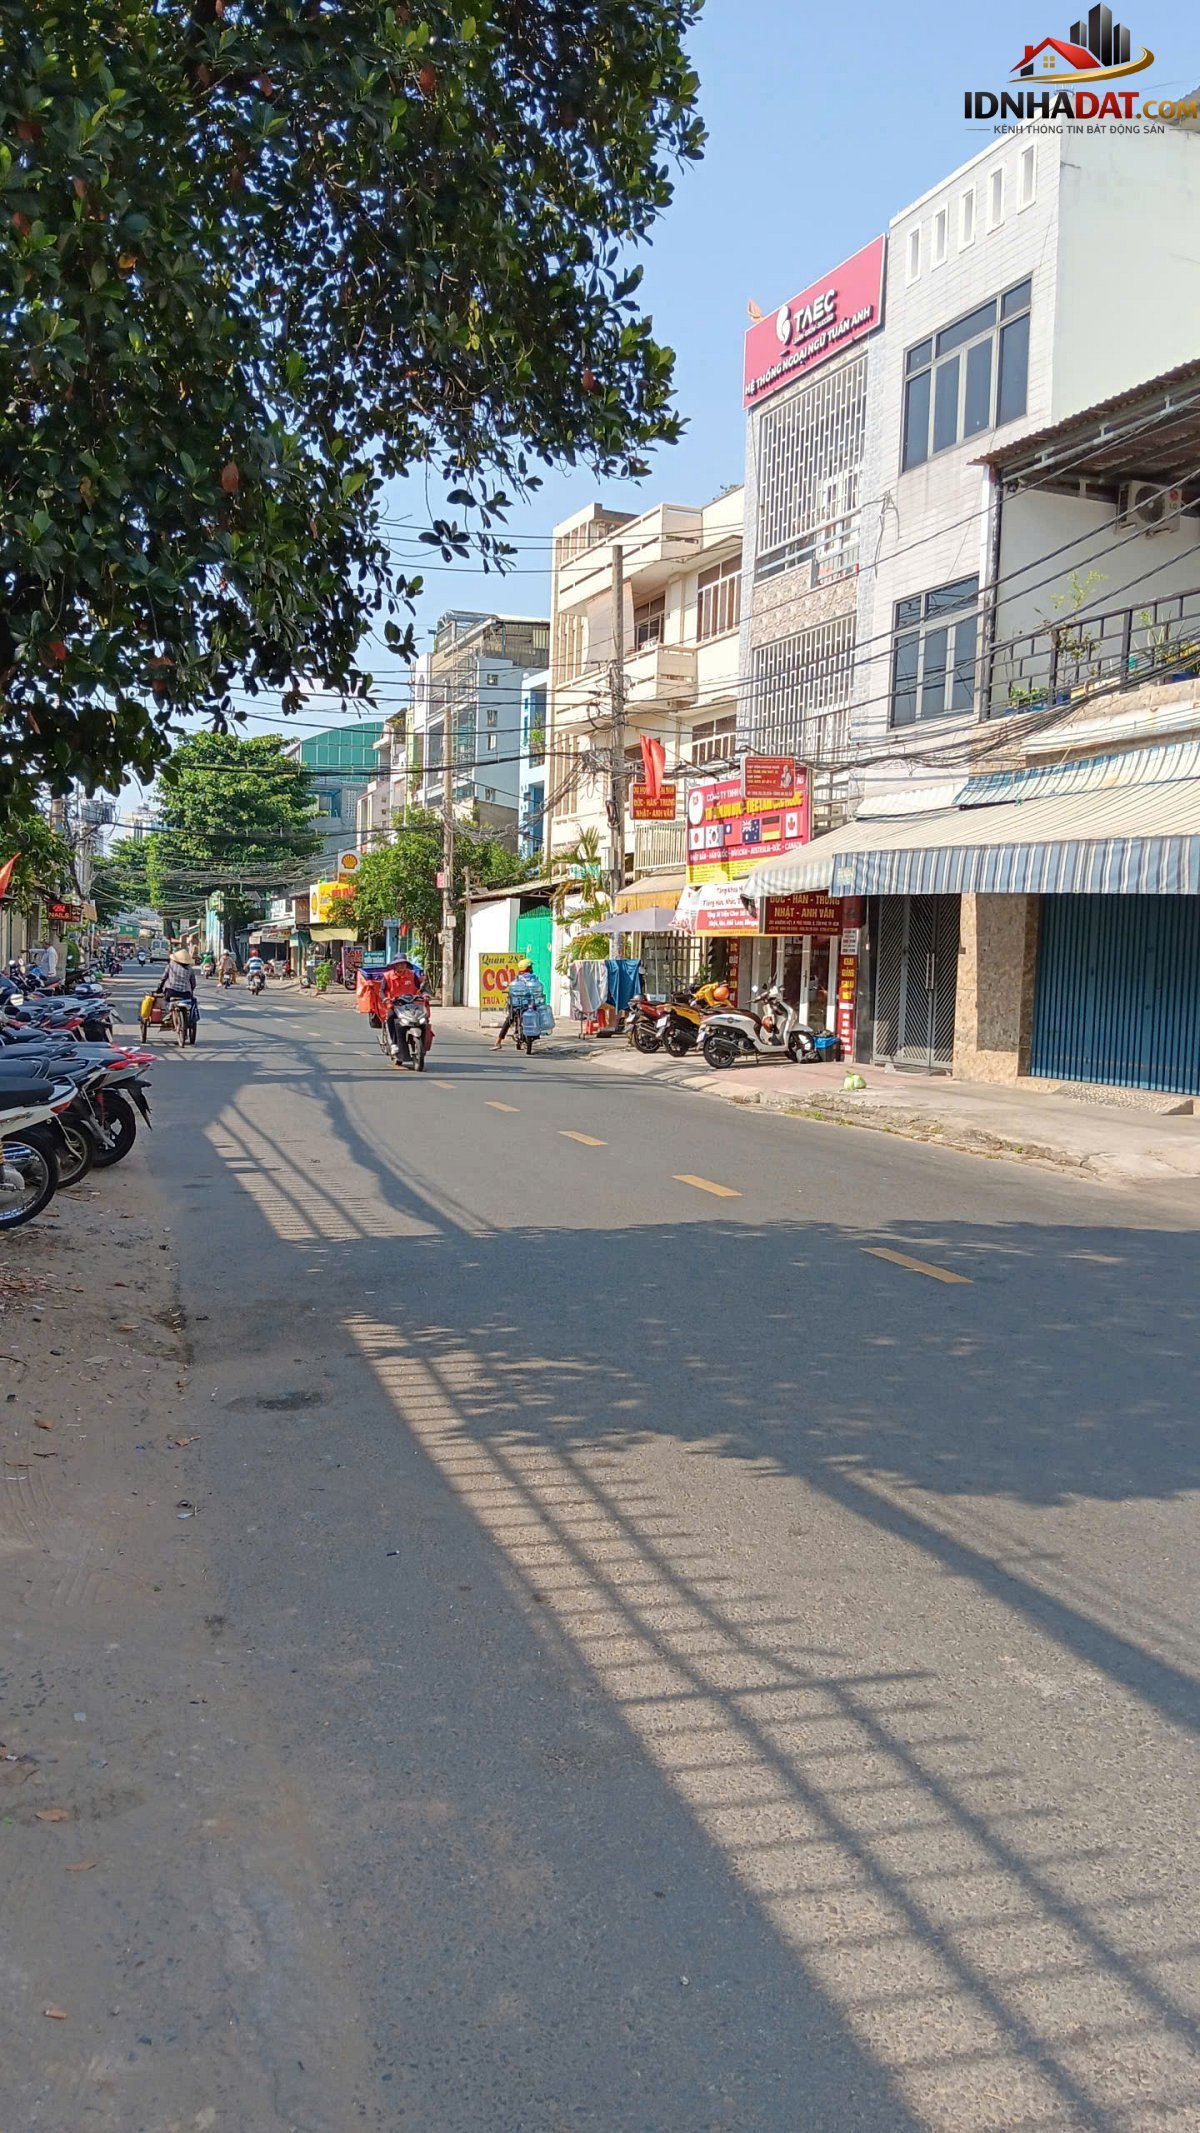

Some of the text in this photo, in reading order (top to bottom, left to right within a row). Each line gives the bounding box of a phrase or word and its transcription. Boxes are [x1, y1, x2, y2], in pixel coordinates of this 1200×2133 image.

[756, 363, 782, 388] THỐNG
[782, 347, 808, 371] NGOẠI
[851, 305, 871, 327] ANH
[801, 908, 818, 918] ANH
[819, 907, 835, 919] VĂN
